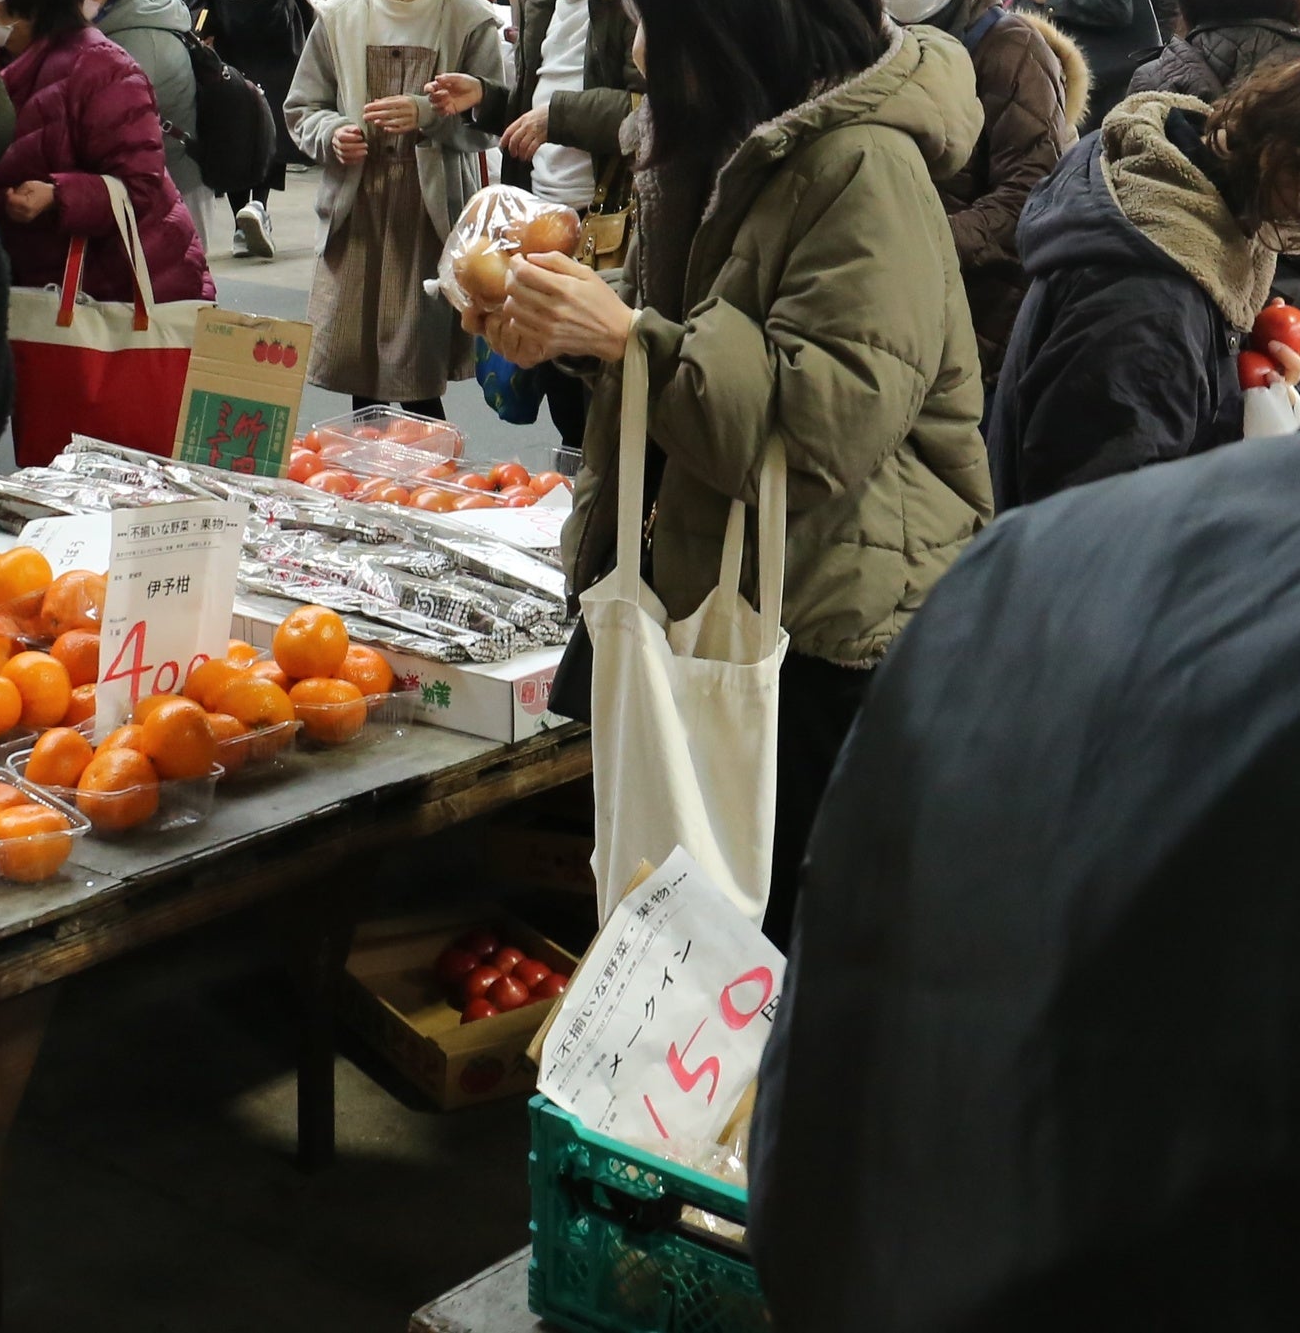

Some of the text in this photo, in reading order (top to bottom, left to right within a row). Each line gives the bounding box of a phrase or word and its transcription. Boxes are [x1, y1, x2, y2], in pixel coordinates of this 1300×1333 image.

[147, 574, 191, 600] 伊予柑
[609, 939, 692, 1079] メークイン
[643, 965, 774, 1141] 150
